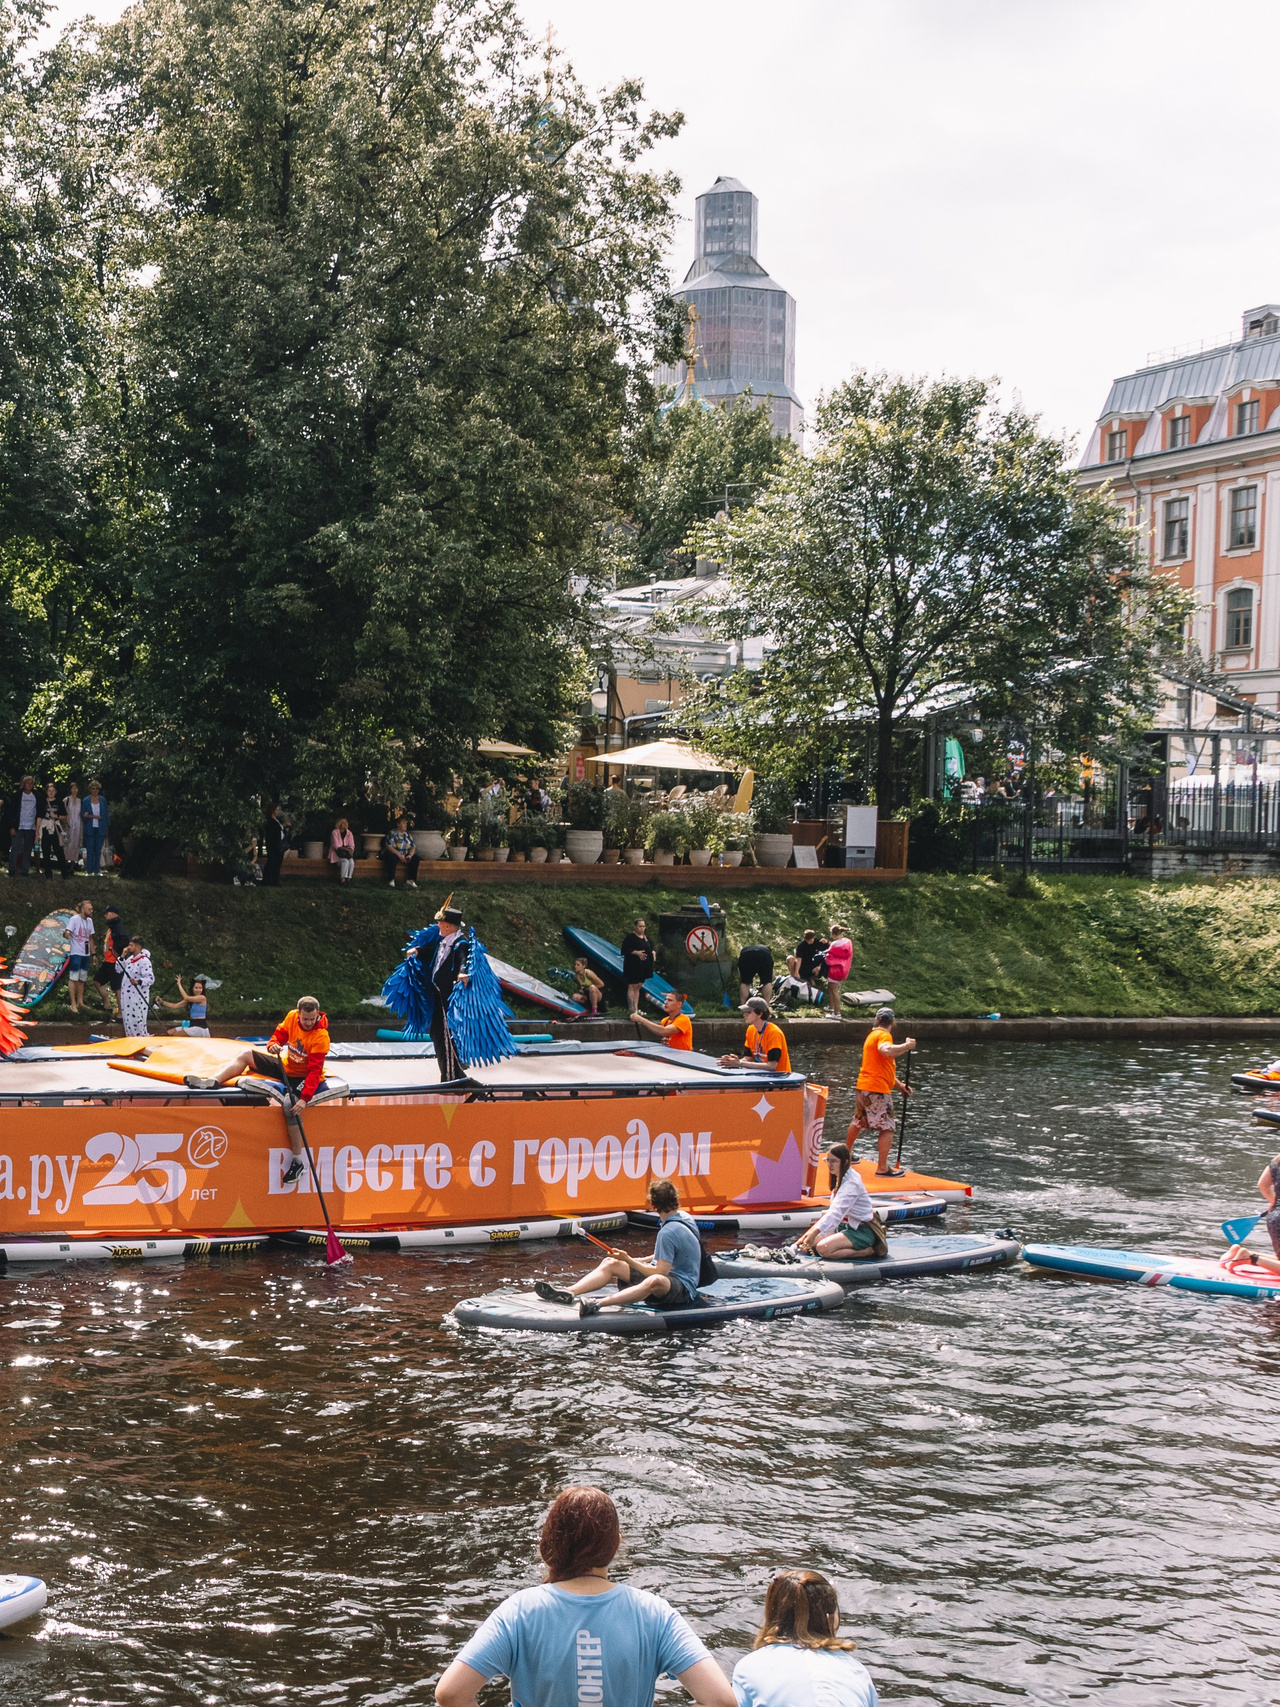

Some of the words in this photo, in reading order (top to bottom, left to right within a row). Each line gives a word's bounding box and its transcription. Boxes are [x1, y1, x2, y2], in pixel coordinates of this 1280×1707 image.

[82, 1132, 187, 1206] 25
[190, 1188, 218, 1201] лет
[468, 1140, 497, 1188] с
[511, 1118, 713, 1198] городом
[111, 1247, 143, 1257] AURORA
[308, 1235, 327, 1245] RAV
